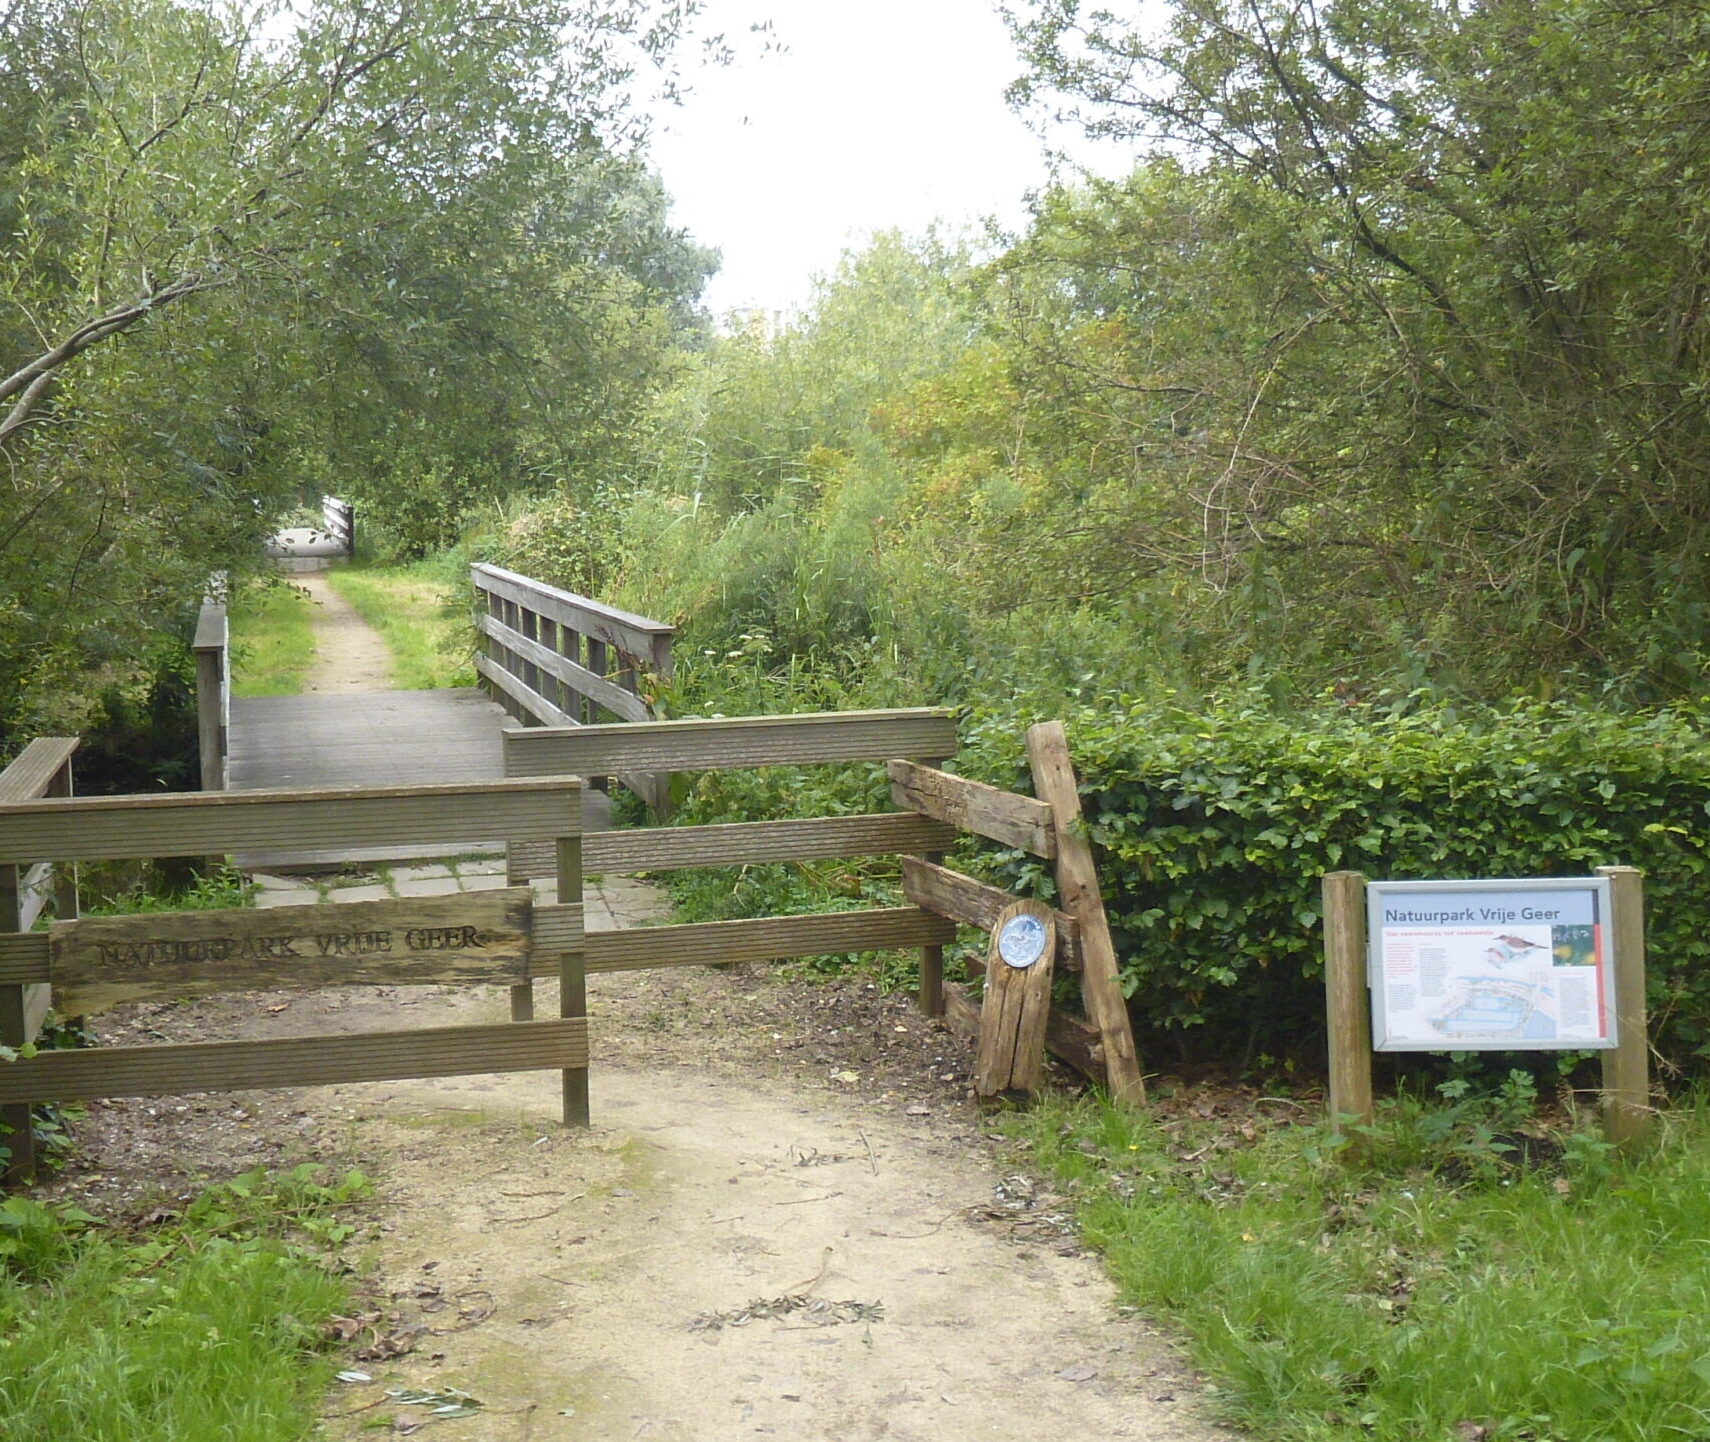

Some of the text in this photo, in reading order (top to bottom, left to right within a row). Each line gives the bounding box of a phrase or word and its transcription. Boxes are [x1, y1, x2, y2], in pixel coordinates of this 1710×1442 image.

[1385, 906, 1561, 924] Natuurpark Vrije Geer
[316, 931, 393, 956] VRIJE
[405, 924, 486, 951] GEER
